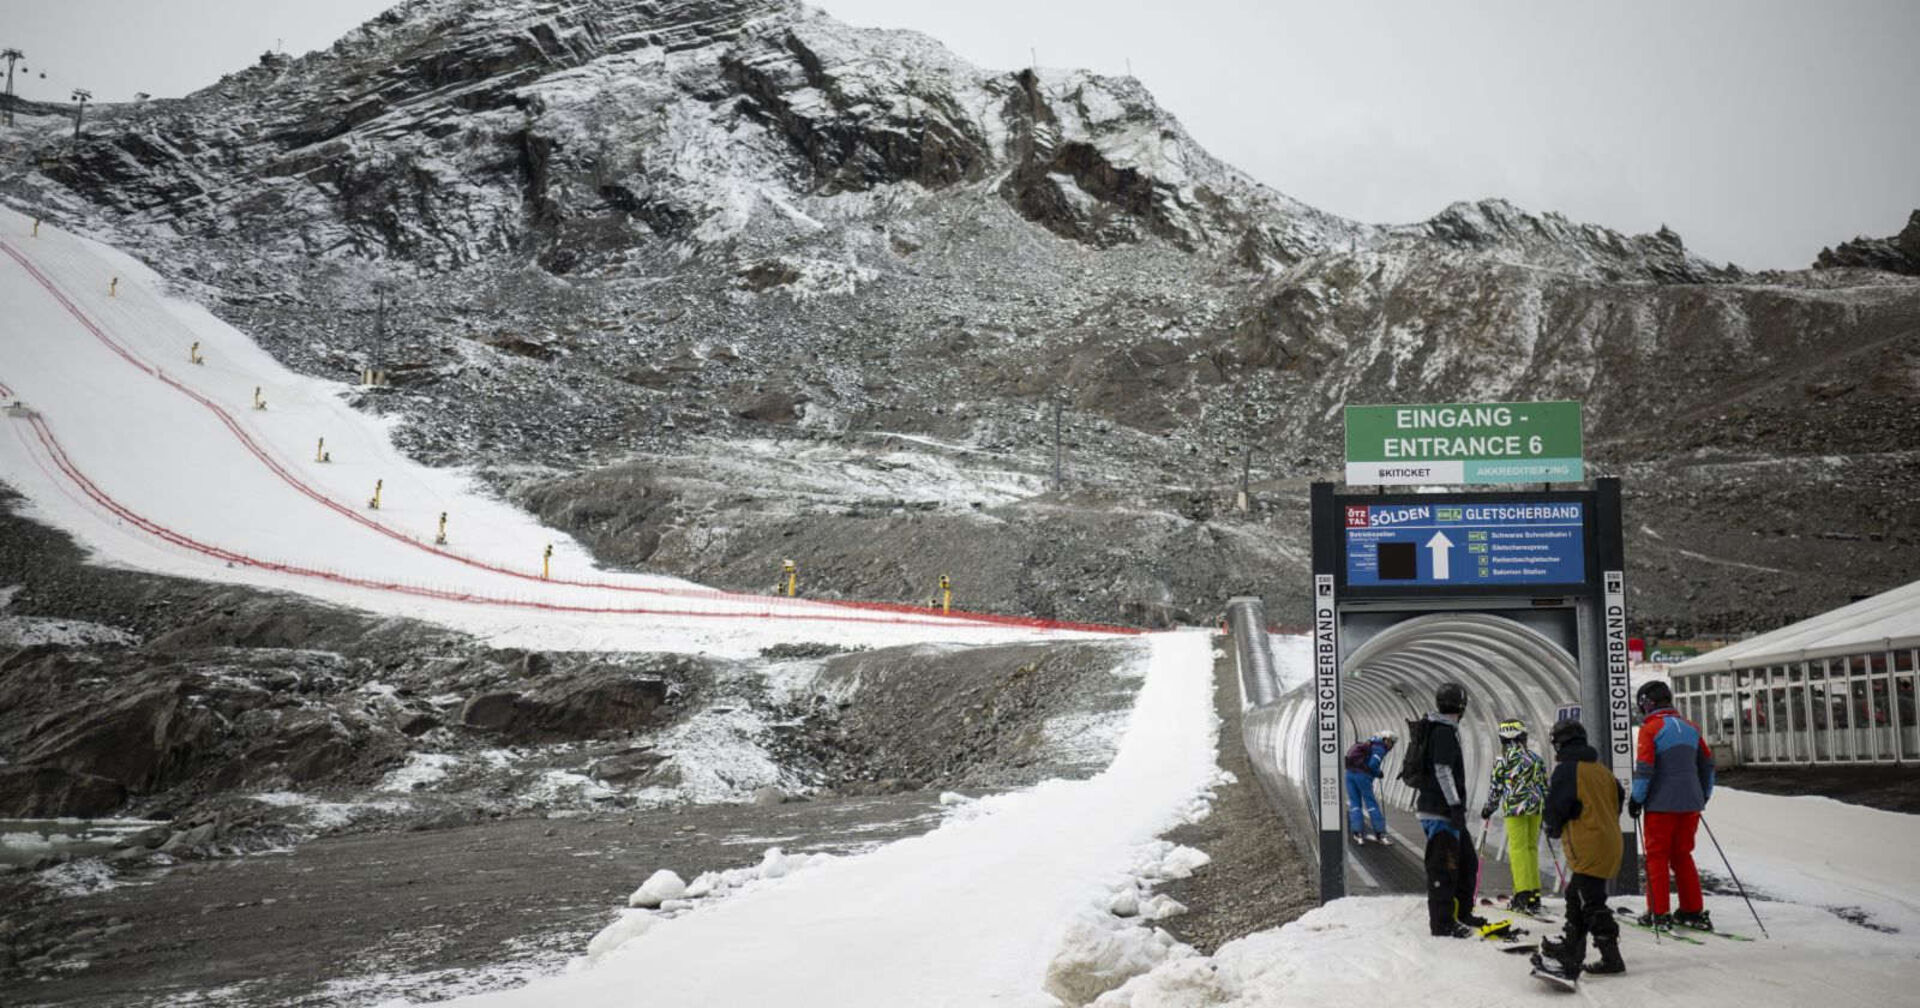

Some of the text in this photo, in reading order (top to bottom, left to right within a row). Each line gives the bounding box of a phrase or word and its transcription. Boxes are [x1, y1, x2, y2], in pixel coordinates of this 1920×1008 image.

[1396, 407, 1512, 429] EINGANG
[1384, 435, 1543, 457] ENTRANCE 6
[1378, 468, 1431, 478] SKITICKET
[1476, 465, 1570, 477] AKKREDITIERUNG
[1347, 508, 1366, 517] ÖTZ
[1370, 506, 1430, 526] SÖLDEN
[1466, 507, 1580, 520] GLETSCHERBAND
[1348, 518, 1367, 526] TAL
[1319, 608, 1336, 754] GLETSCHERBAND
[1608, 605, 1629, 754] GLETSCHERBAND
